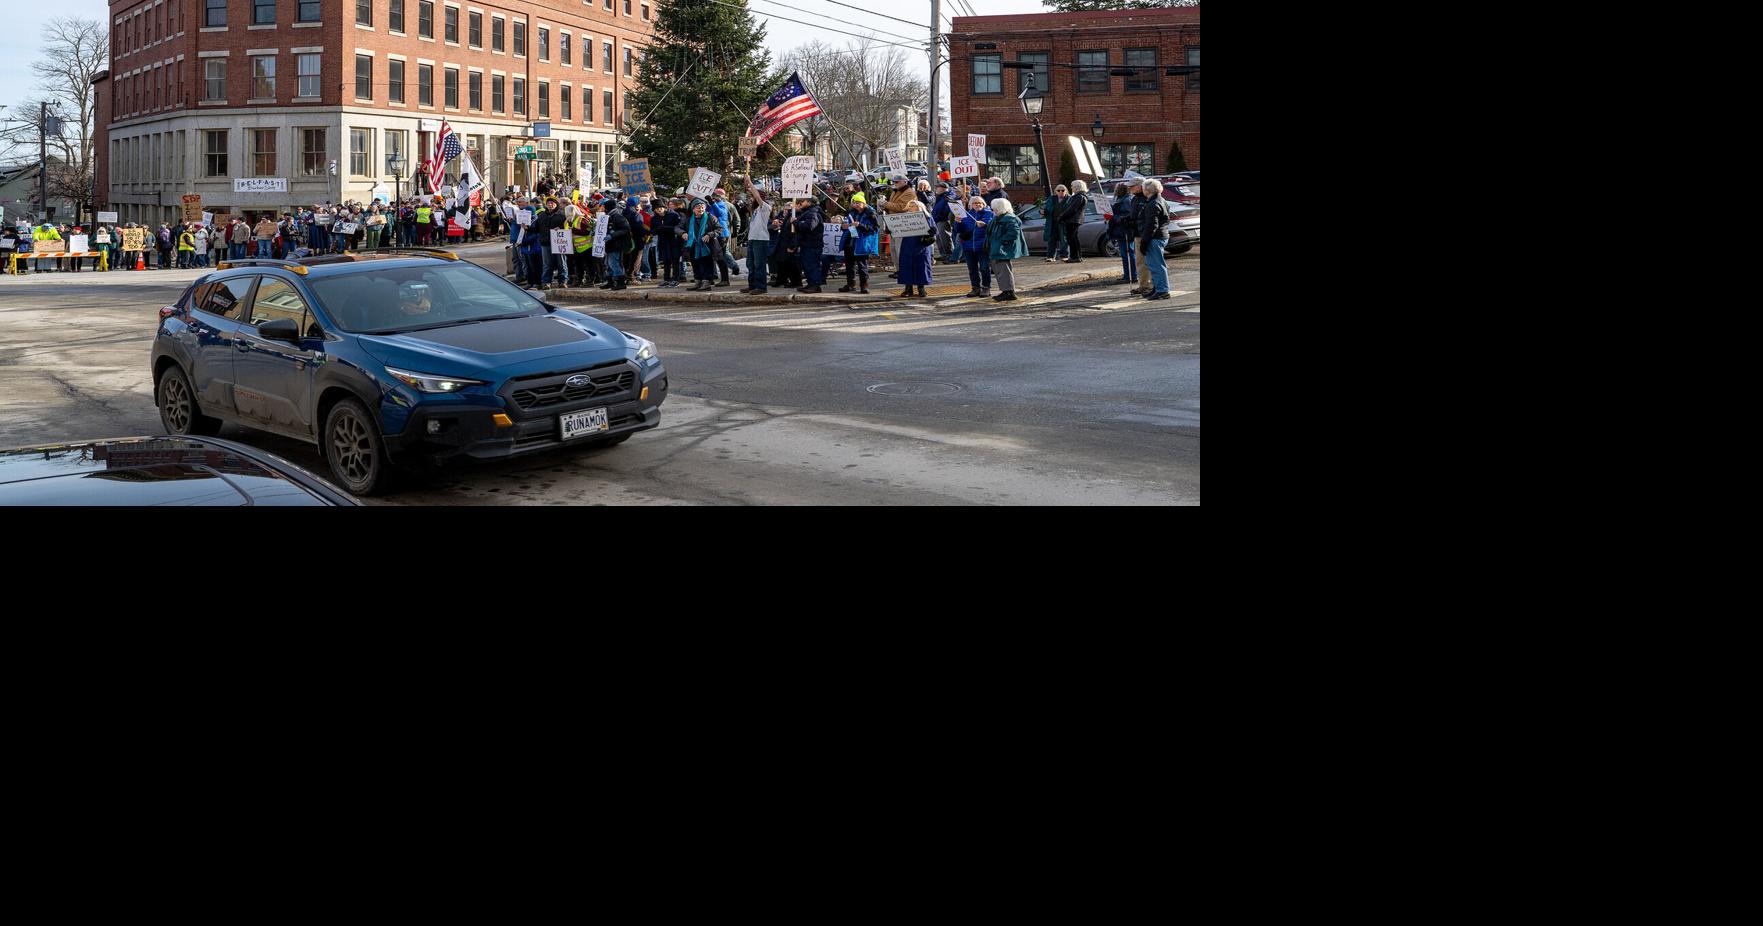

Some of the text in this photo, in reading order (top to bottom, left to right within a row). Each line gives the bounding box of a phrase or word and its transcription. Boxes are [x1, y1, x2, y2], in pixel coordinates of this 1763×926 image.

[888, 149, 899, 160] ICE
[891, 161, 904, 170] OUT
[955, 165, 973, 175] OUT
[624, 172, 646, 185] ICE
[698, 172, 714, 182] ICE
[558, 245, 567, 253] US
[567, 413, 606, 431] RUNAMOK
